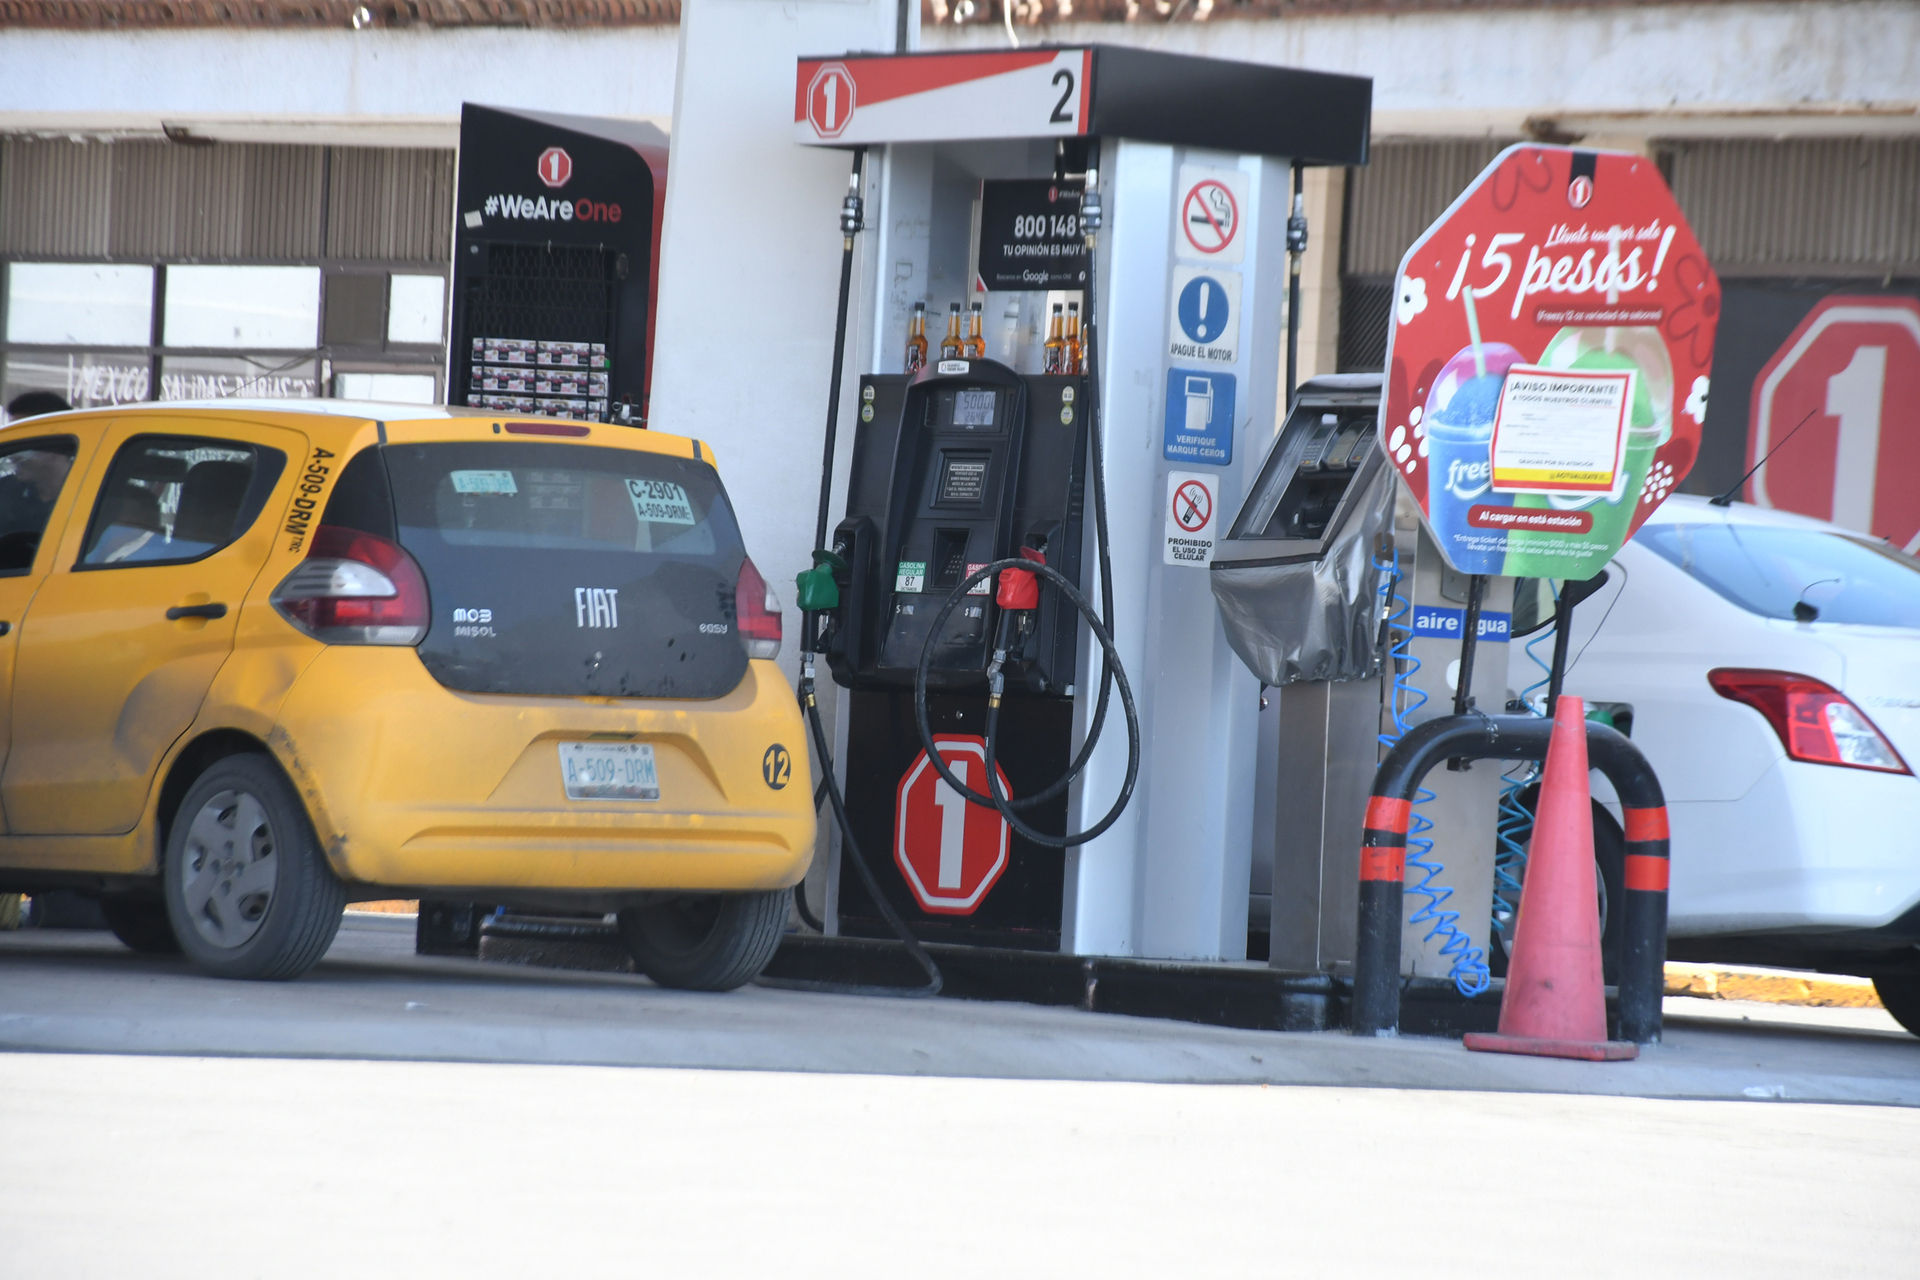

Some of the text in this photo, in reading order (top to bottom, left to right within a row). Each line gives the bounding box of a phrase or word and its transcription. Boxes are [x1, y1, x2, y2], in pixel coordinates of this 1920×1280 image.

[1049, 68, 1075, 124] 2
[1014, 214, 1046, 238] 800
[1050, 214, 1077, 238] 148
[1003, 244, 1014, 256] TU
[1014, 242, 1049, 256] OPINIÓN
[1050, 244, 1060, 256] ES
[1061, 244, 1080, 256] MUY
[1022, 269, 1049, 284] Google
[1511, 225, 1677, 319] pesos!
[1197, 346, 1205, 358] EL
[1207, 347, 1232, 361] MOTOR
[1176, 434, 1216, 446] VERIFIQUE
[1167, 444, 1225, 458] MARQUE CEROS
[285, 446, 335, 535] A-509-DRM
[629, 480, 682, 501] C-2901
[1479, 511, 1488, 522] Al
[1489, 512, 1516, 524] cargar
[1517, 514, 1528, 523] en
[1547, 515, 1582, 526] estación
[1168, 537, 1212, 548] PROHIBIDO
[1174, 552, 1204, 562] CELULAR
[1182, 547, 1196, 555] USO
[1198, 548, 1207, 556] DE
[905, 576, 915, 587] 87
[574, 587, 618, 628] FIAT
[1416, 612, 1507, 635] aire gua
[568, 757, 655, 784] A-509-DRM
[766, 749, 789, 784] 12
